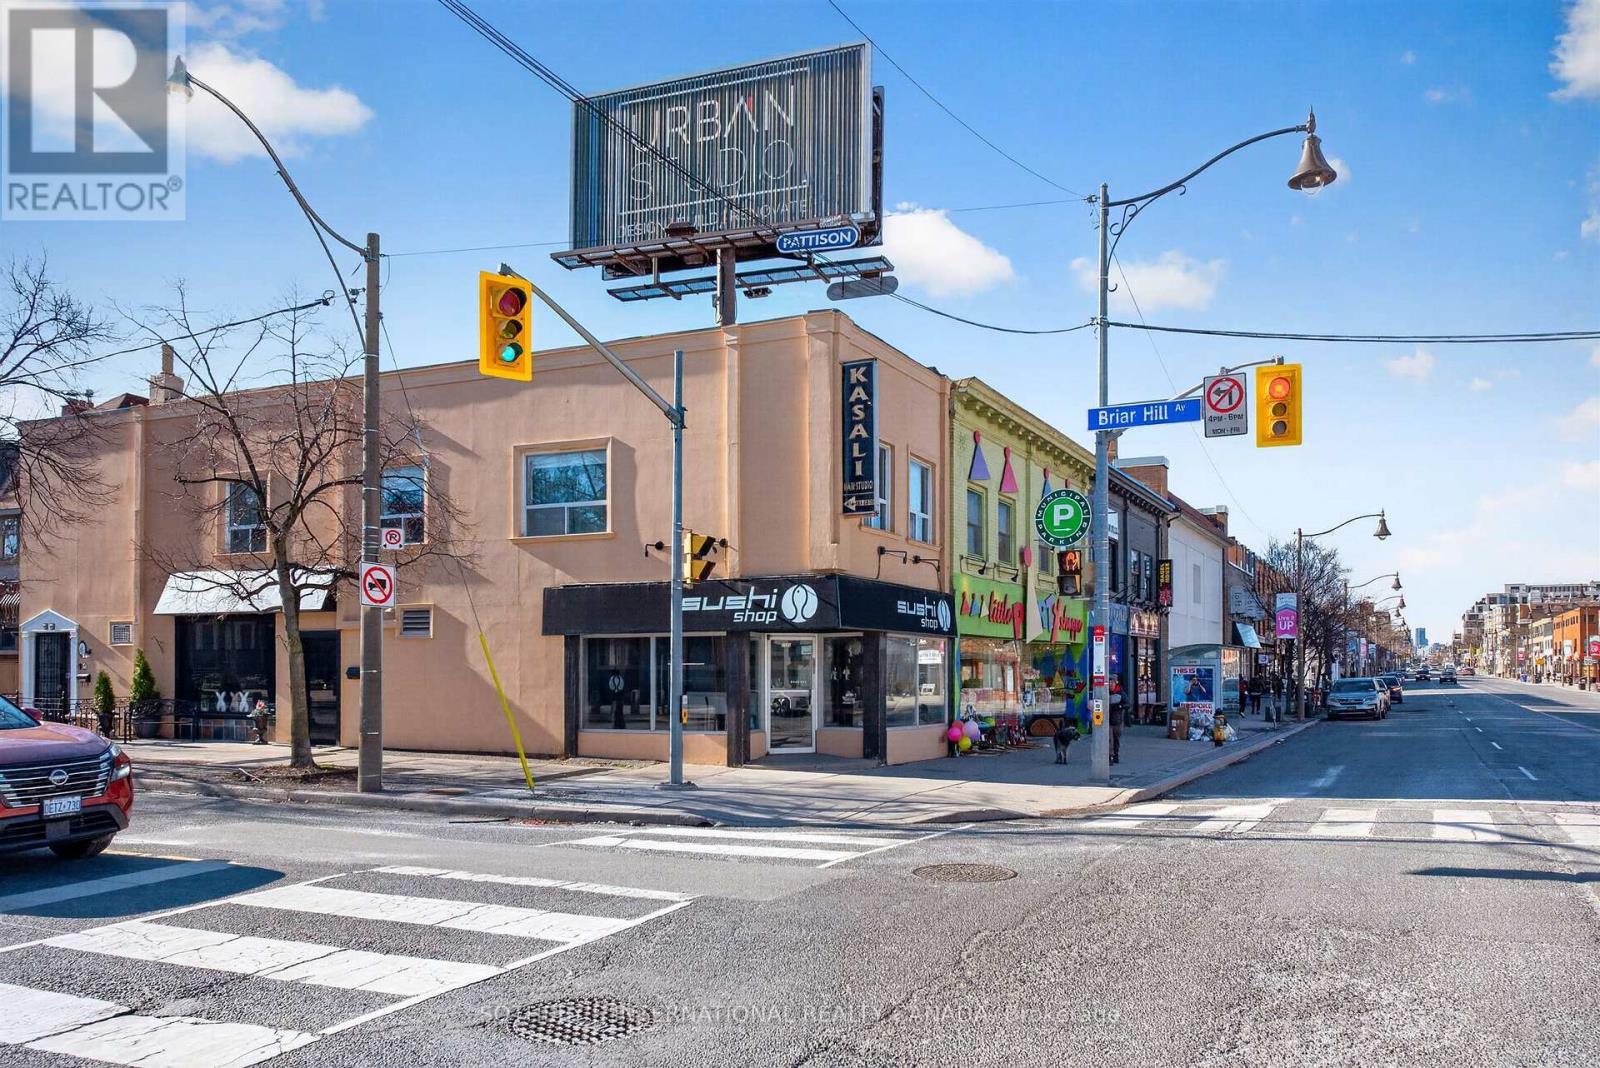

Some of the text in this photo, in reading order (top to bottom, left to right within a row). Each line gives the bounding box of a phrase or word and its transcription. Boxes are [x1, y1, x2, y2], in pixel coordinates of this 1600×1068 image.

[631, 85, 794, 151] URBAN
[631, 139, 794, 201] SUDO
[783, 231, 852, 249] PATTISON
[848, 366, 870, 477] KASALI
[1098, 409, 1137, 426] Briar
[1143, 404, 1169, 422] Hill
[1037, 491, 1089, 517] MUNICIPAL
[1053, 503, 1075, 527] P
[1038, 522, 1088, 545] PARKING
[682, 586, 778, 611] sushi
[897, 596, 937, 618] sushi
[733, 609, 778, 625] shop
[921, 616, 939, 631] shop
[1280, 620, 1294, 630] UP
